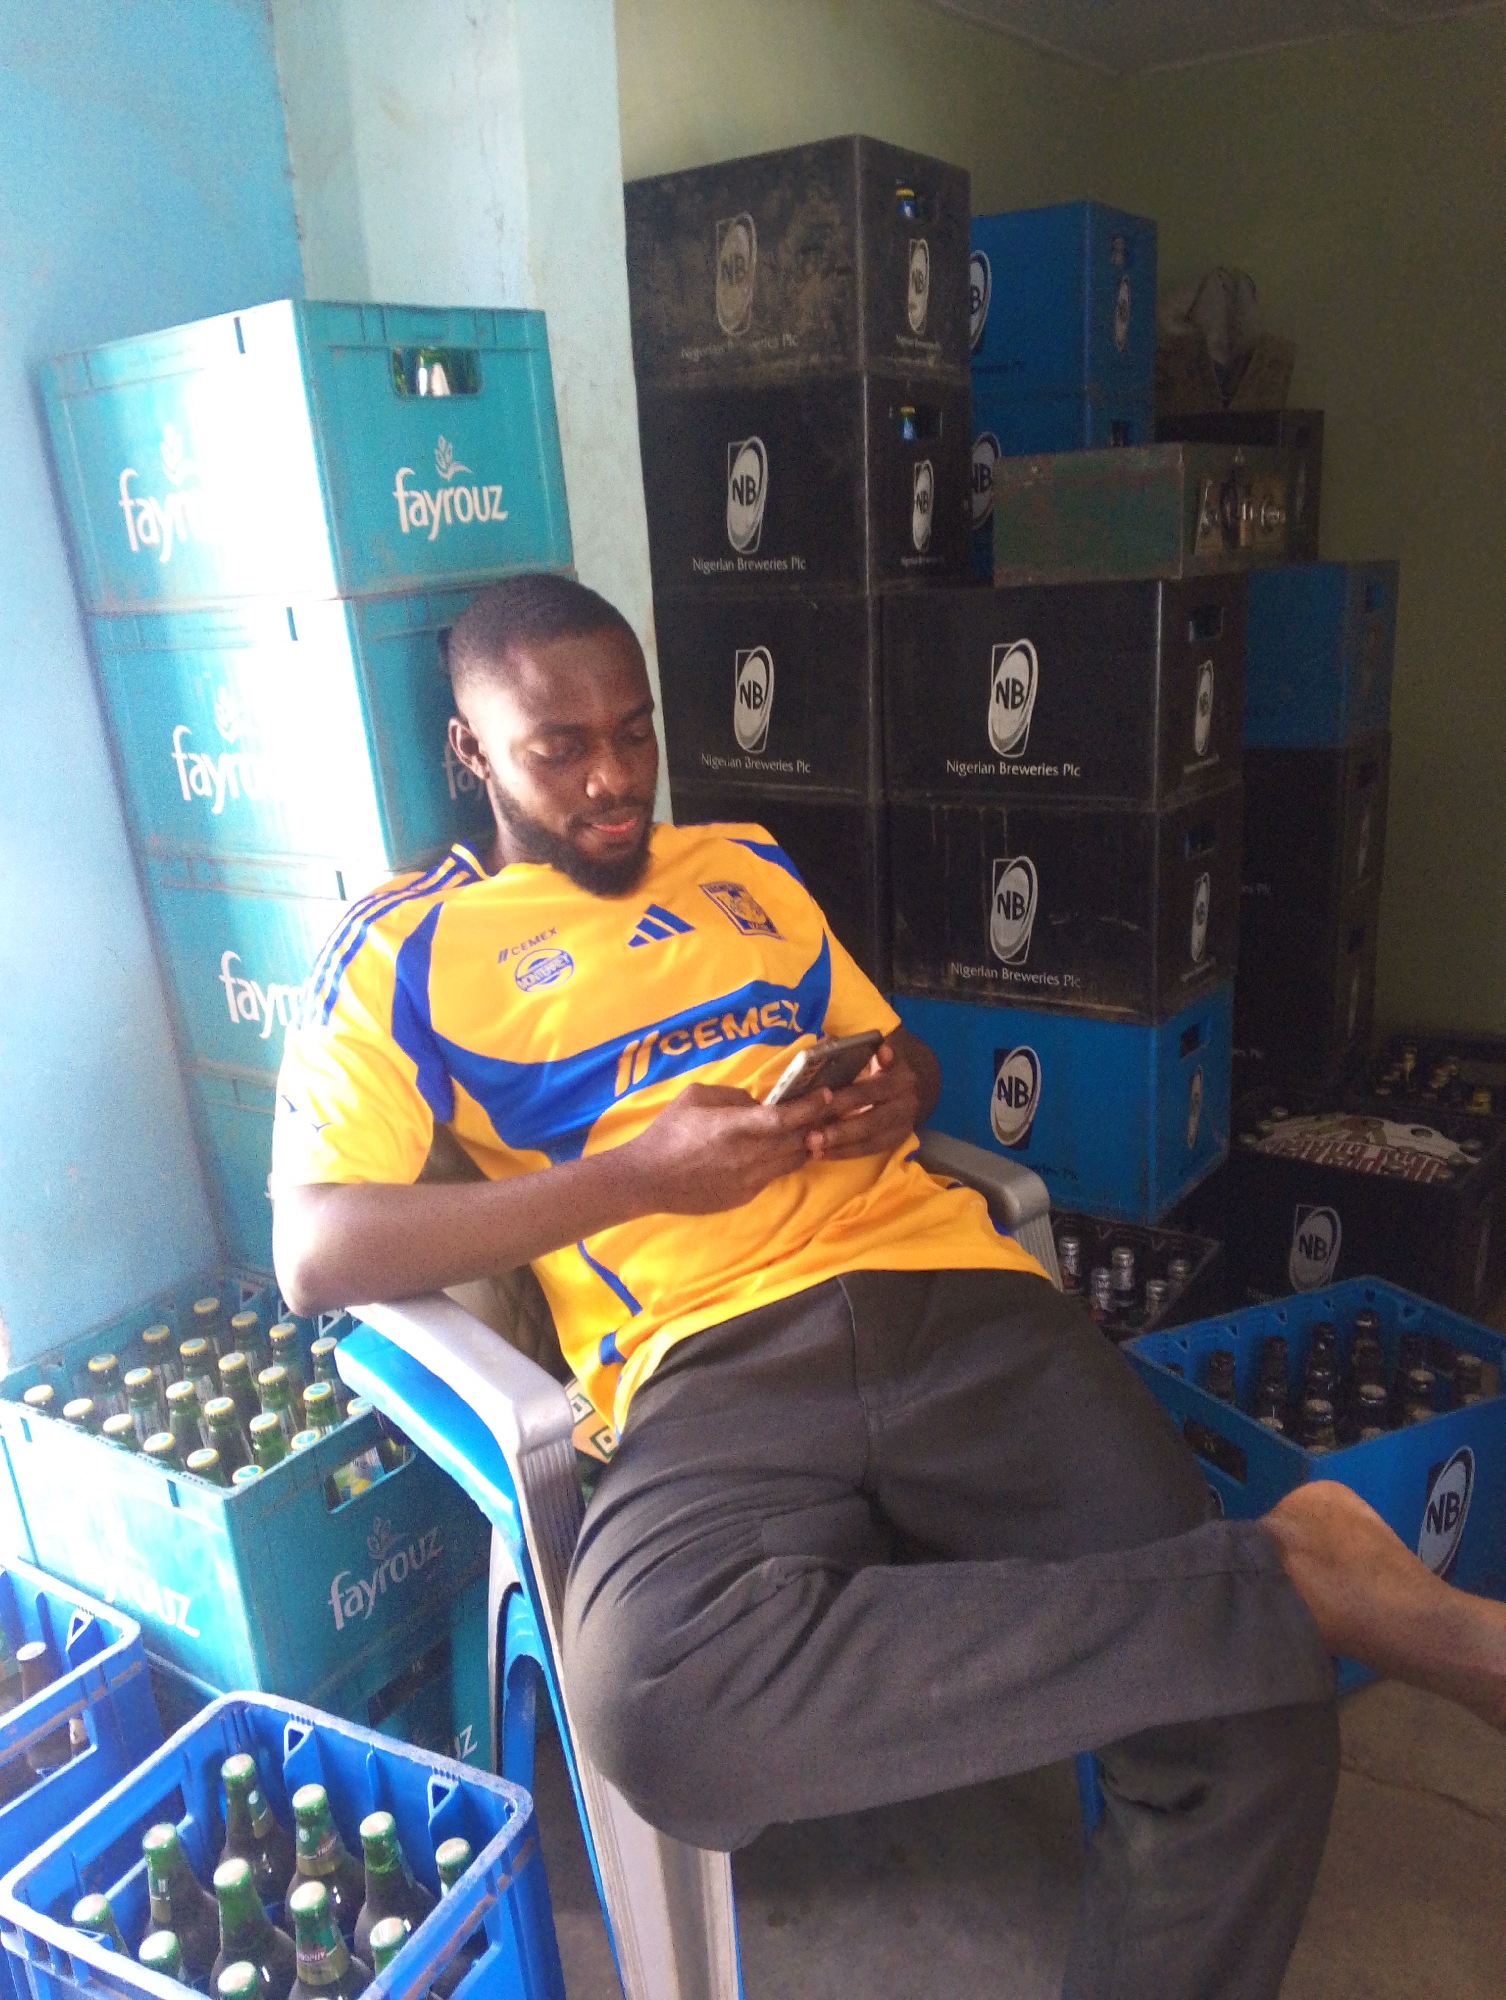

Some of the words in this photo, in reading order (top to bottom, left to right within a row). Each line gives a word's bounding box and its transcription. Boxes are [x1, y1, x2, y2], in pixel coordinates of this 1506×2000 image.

[392, 467, 509, 541] fayrouz
[732, 474, 757, 506] NB
[693, 557, 735, 575] Nigerian
[737, 557, 788, 571] Breweries
[791, 555, 807, 571] Plc
[740, 680, 763, 710] NB
[996, 678, 1024, 710] NB
[701, 753, 742, 770] Nigerian
[744, 756, 794, 773] Breweries
[796, 760, 811, 774] Plc
[946, 760, 995, 777] Nigerian
[1000, 761, 1059, 776] Breweries
[1063, 763, 1081, 777] Plc
[997, 890, 1025, 920] NB
[511, 927, 557, 956] CEMEX
[950, 962, 998, 979] Nigerian
[1001, 967, 1060, 986] Breweries
[1063, 973, 1082, 988] Plc
[659, 999, 803, 1056] CEMEX
[997, 1075, 1030, 1109] NB
[1298, 1233, 1328, 1261] NB
[1426, 1491, 1461, 1535] NB
[328, 1526, 443, 1631] fayrouz
